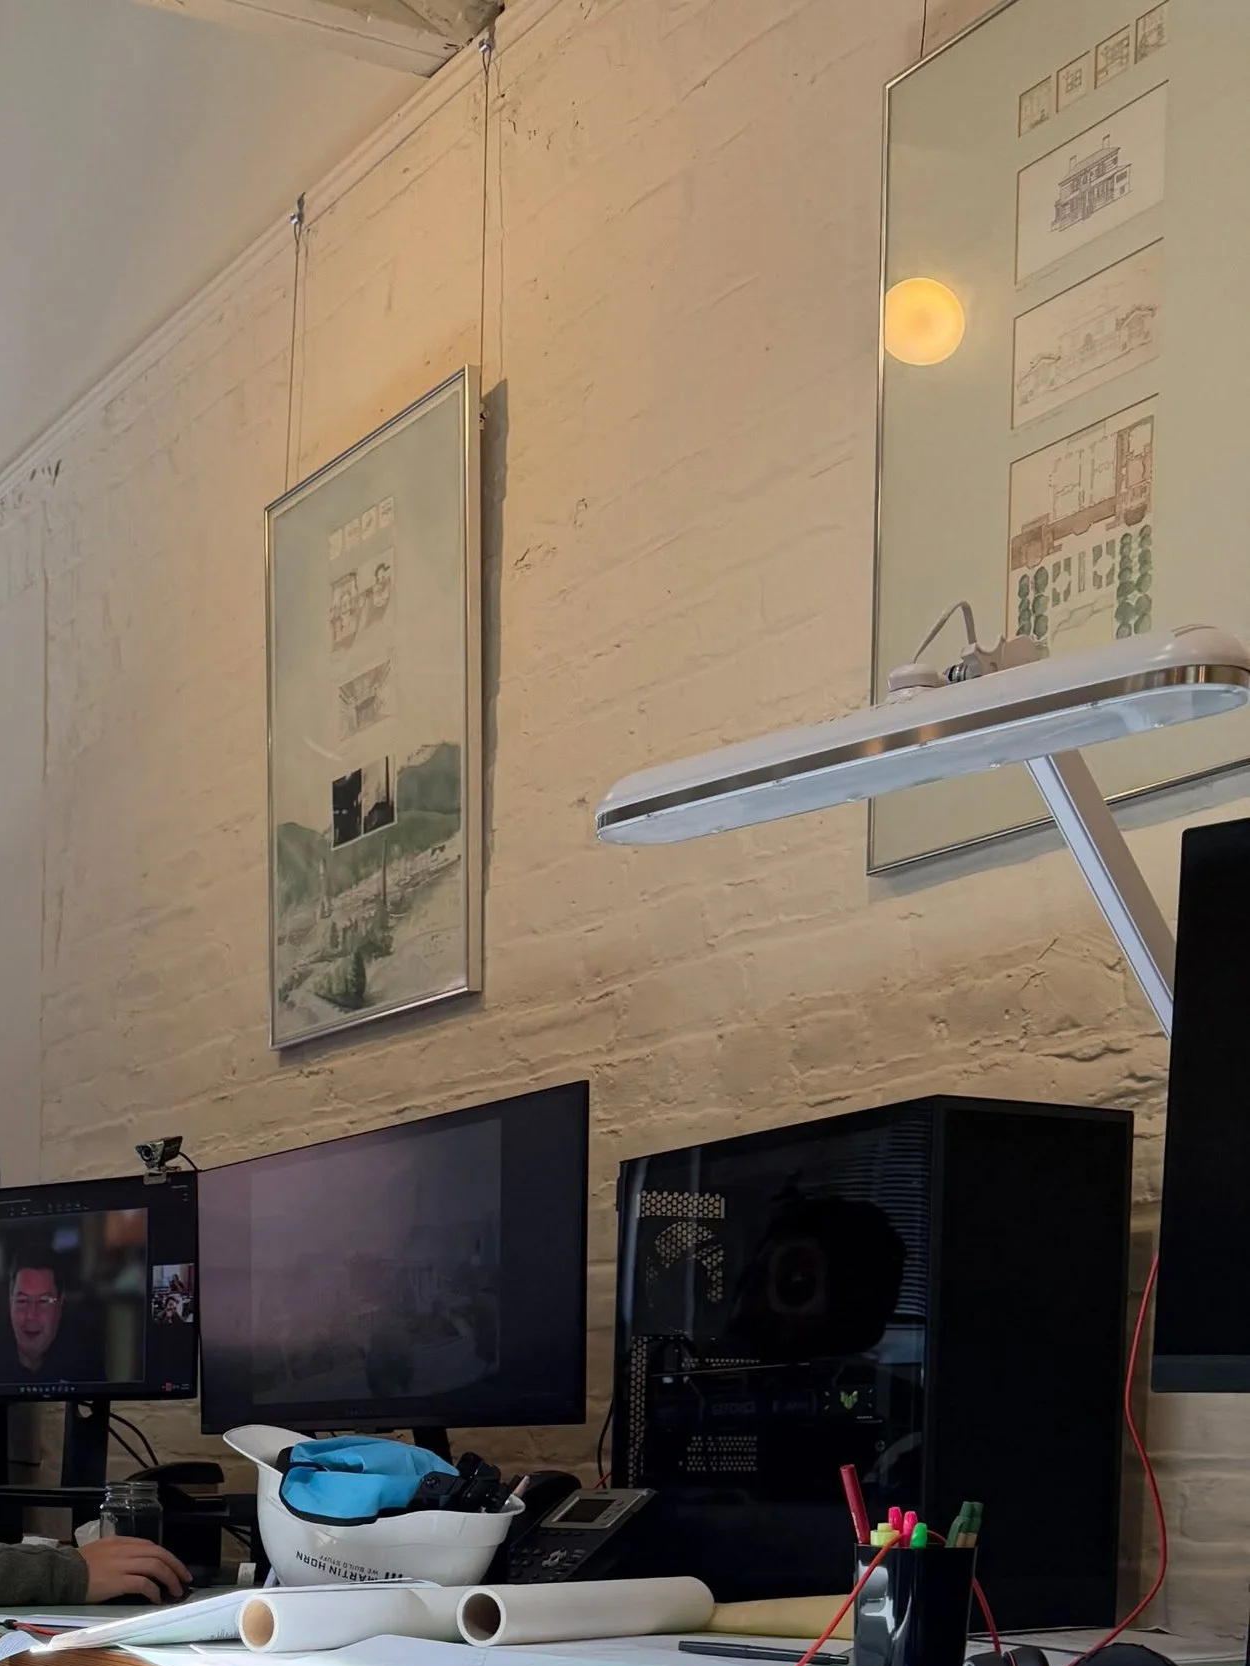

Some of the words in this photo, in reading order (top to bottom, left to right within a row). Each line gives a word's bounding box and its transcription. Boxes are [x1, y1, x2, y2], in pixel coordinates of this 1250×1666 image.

[295, 1550, 326, 1571] HORN
[318, 1554, 341, 1567] STUFF
[342, 1561, 366, 1574] BUILD
